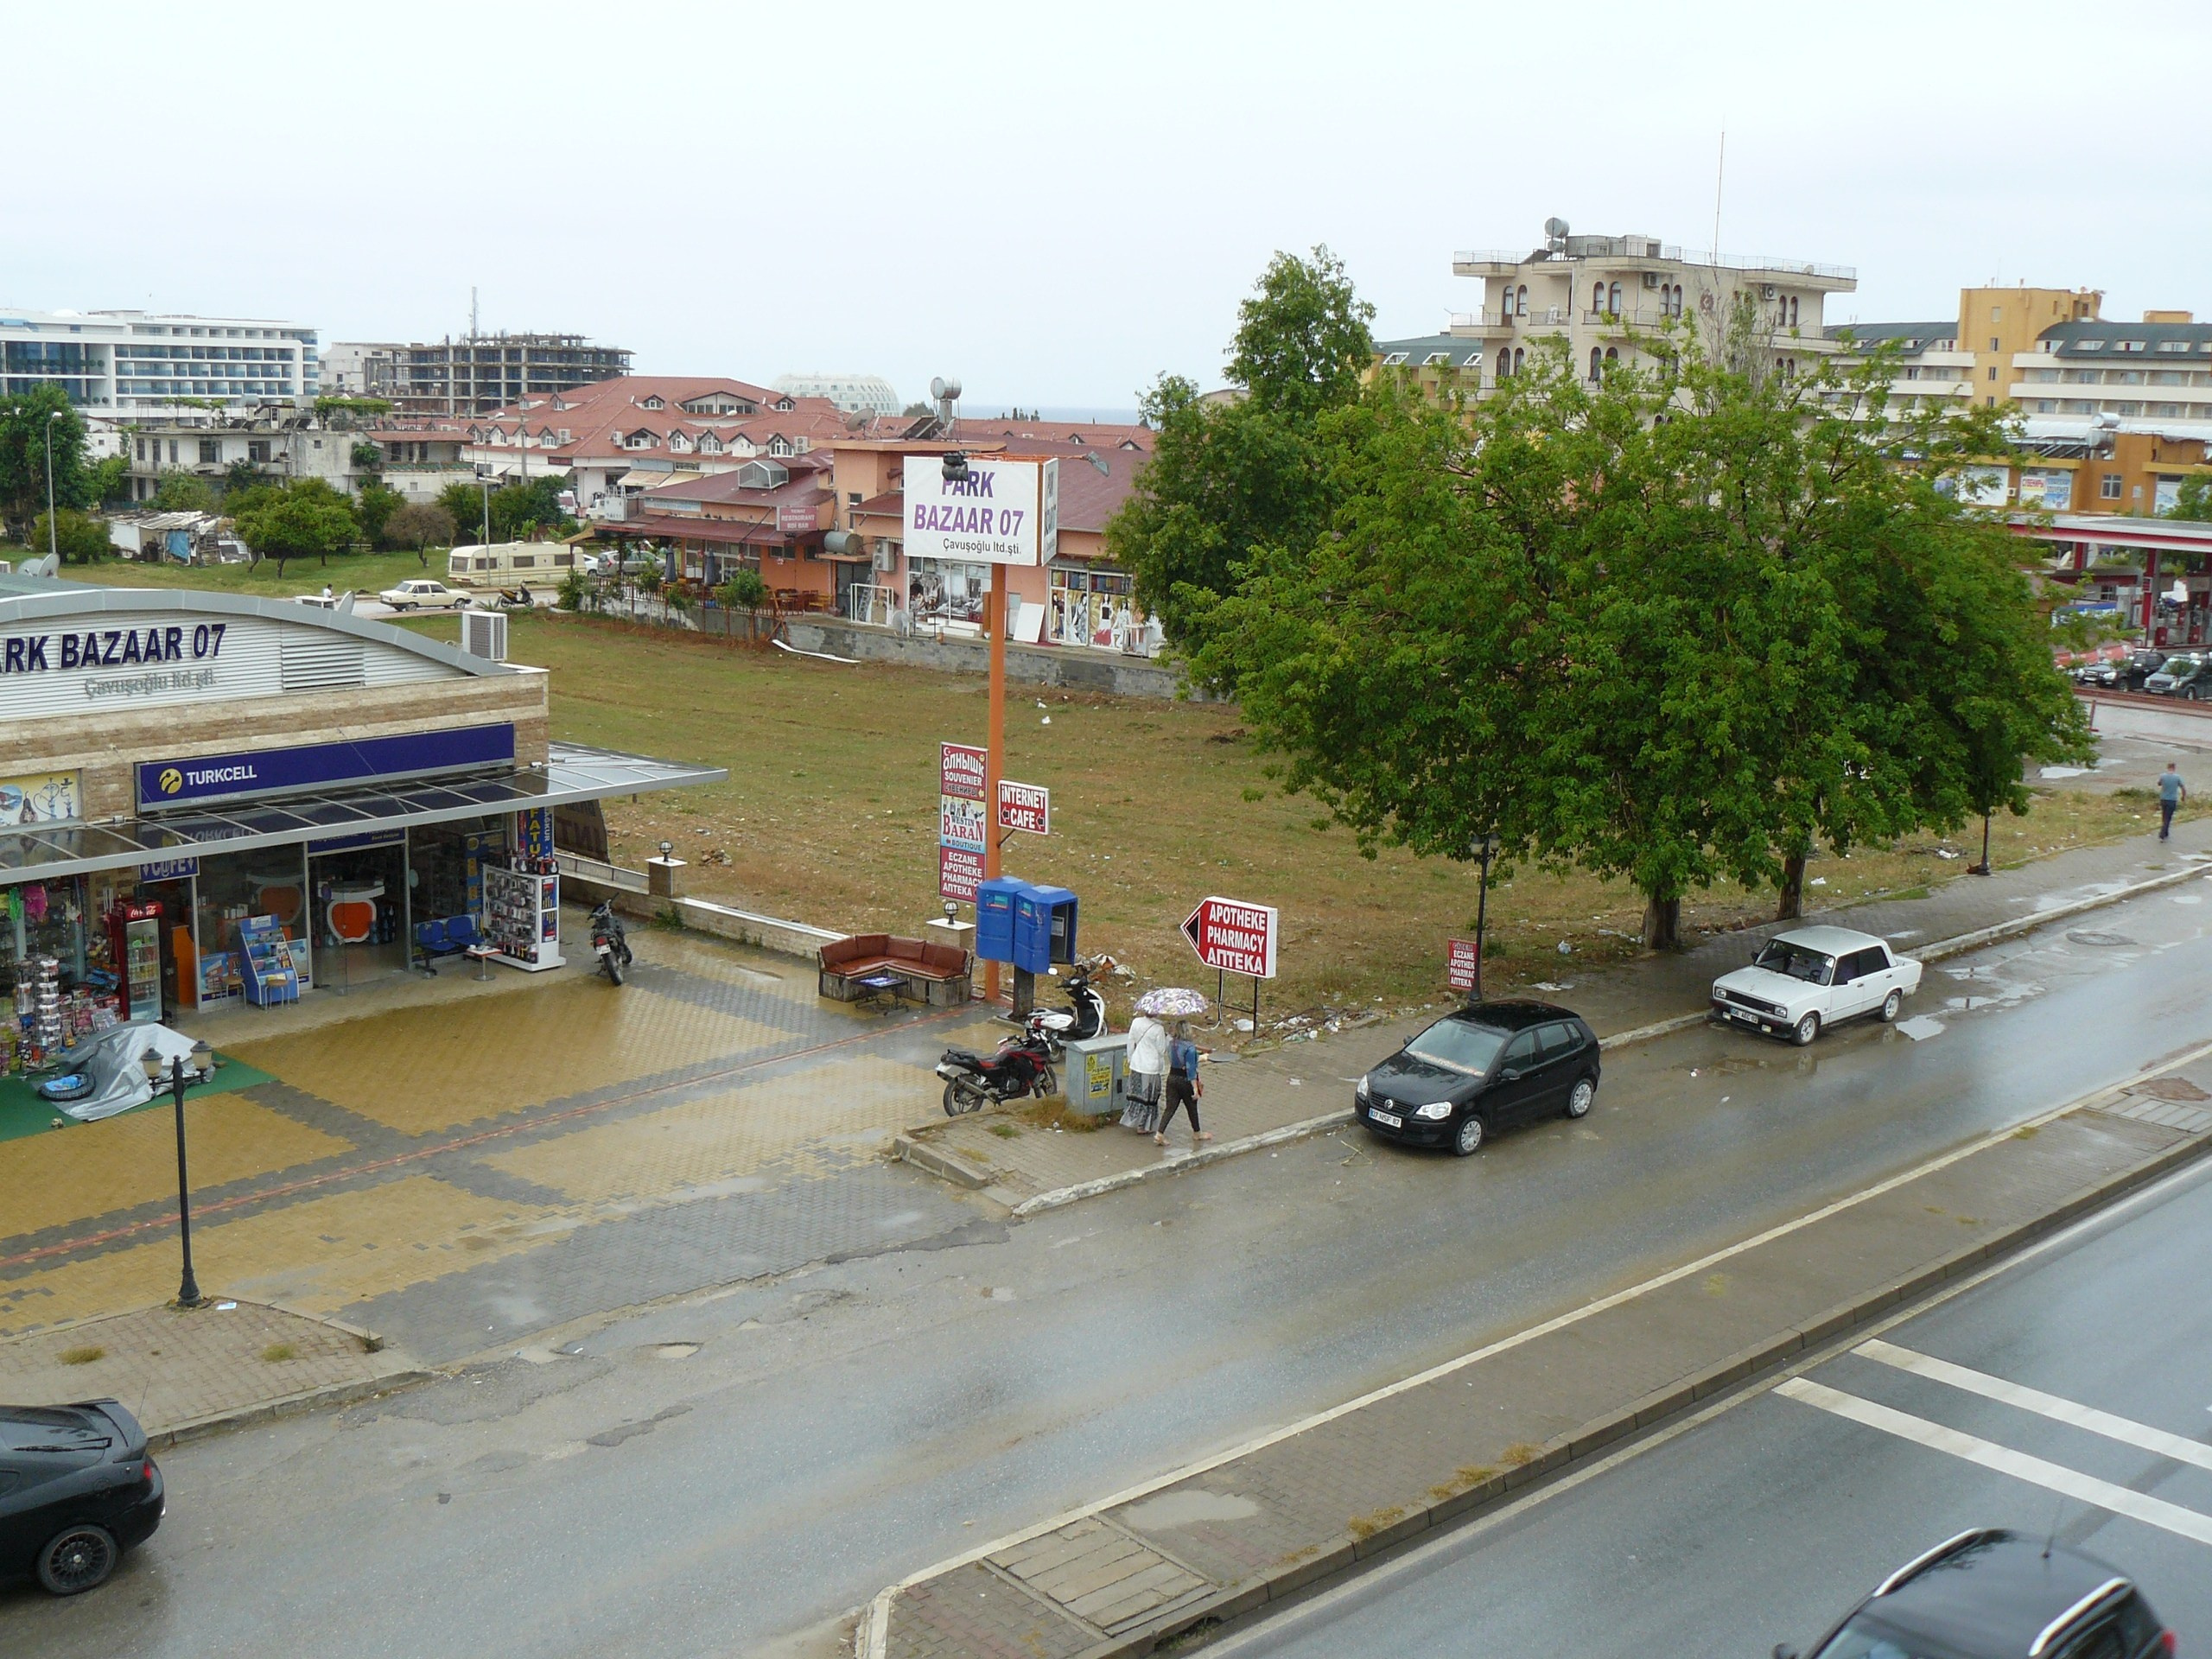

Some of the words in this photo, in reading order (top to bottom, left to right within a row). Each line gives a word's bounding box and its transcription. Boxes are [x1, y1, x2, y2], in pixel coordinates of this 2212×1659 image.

[913, 504, 993, 535] BAZAAR
[1000, 508, 1024, 537] 07
[943, 538, 991, 555] Çavuşoğlu
[0, 635, 50, 673] RK
[61, 626, 184, 669] BAZAAR
[193, 623, 227, 658] 07
[186, 765, 257, 786] TURKCELL
[944, 771, 982, 786] SOUVENIER
[951, 816, 975, 827] WESTIN
[1010, 808, 1036, 830] CAFE
[951, 839, 982, 851] BOUTIQUE
[948, 851, 977, 866] ECZANE
[944, 861, 982, 878] APOTHEKE
[943, 882, 972, 897] АПТЕКА
[1209, 903, 1266, 931] APOTHEKE
[1207, 925, 1265, 954] PHARMACY
[1206, 947, 1263, 974] АПТЕКА
[1450, 957, 1475, 969] APOTHEK
[1453, 950, 1475, 961] ECZANE
